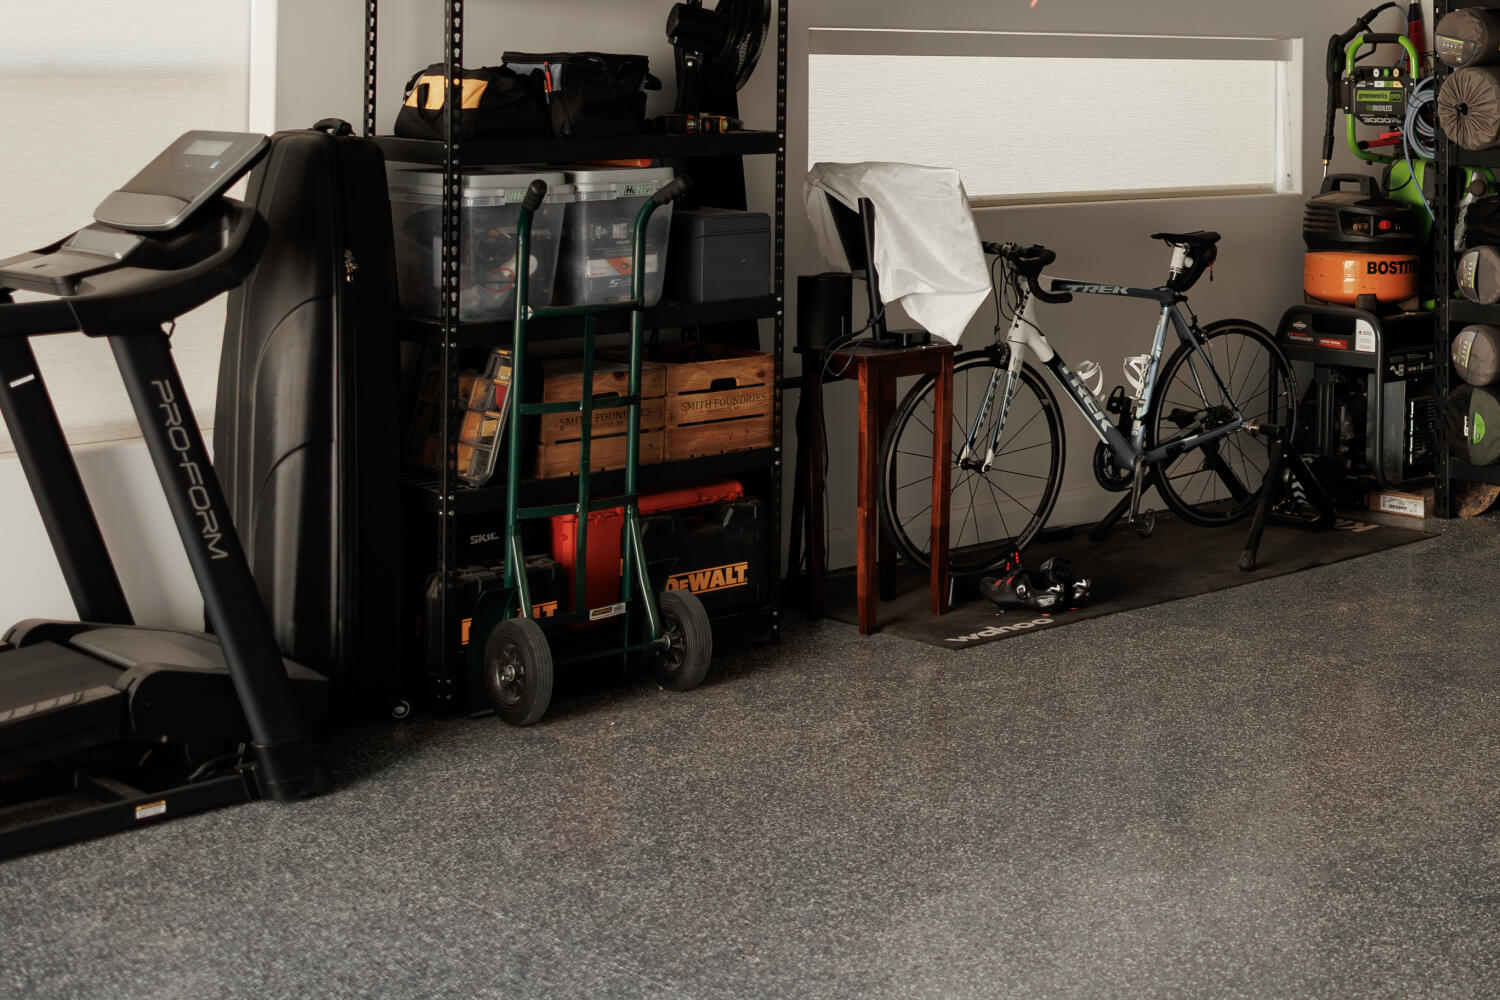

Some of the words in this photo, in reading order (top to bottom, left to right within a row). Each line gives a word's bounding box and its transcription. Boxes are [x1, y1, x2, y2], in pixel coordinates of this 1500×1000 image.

[1358, 92, 1388, 101] greenworks
[1367, 260, 1417, 274] BOSTIT
[1064, 284, 1129, 295] TREK
[681, 400, 712, 411] SMITH
[713, 393, 767, 407] FOUNDRIES
[1059, 362, 1114, 433] TREK
[151, 378, 229, 560] PRO-FORM
[469, 531, 500, 545] SKIL
[944, 618, 1055, 642] wahoo
